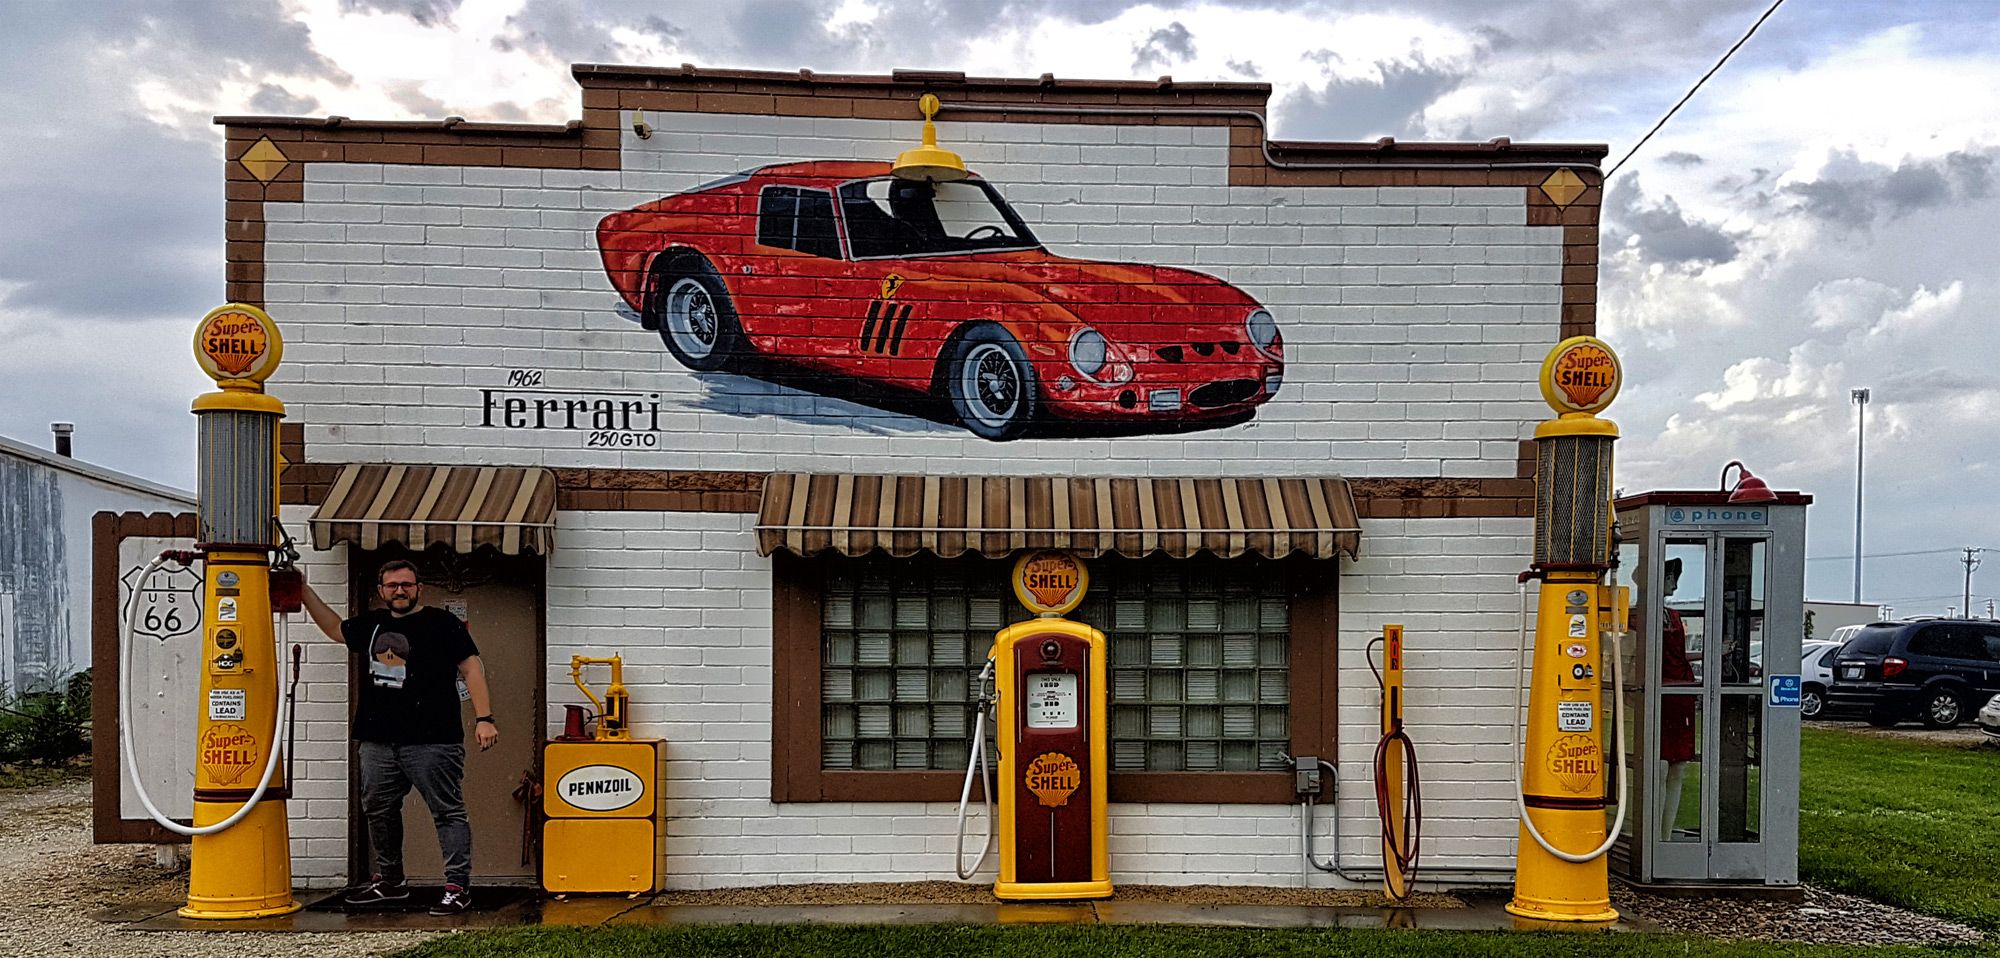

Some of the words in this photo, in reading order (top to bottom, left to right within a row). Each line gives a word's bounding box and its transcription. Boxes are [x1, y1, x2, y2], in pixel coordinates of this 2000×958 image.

[208, 338, 258, 355] SHELL
[507, 369, 543, 387] 1962
[1561, 370, 1607, 387] SHELL
[479, 388, 661, 432] Ferrari
[587, 431, 619, 447] 250
[620, 433, 656, 447] GTO
[1691, 508, 1762, 522] phone
[1029, 574, 1072, 589] SHELL
[144, 606, 182, 632] 66
[1391, 630, 1399, 670] AIR
[203, 749, 252, 765] SHELL
[1552, 759, 1597, 774] SHELL
[568, 778, 632, 796] PENNZOIL
[1030, 776, 1075, 790] SHELL
